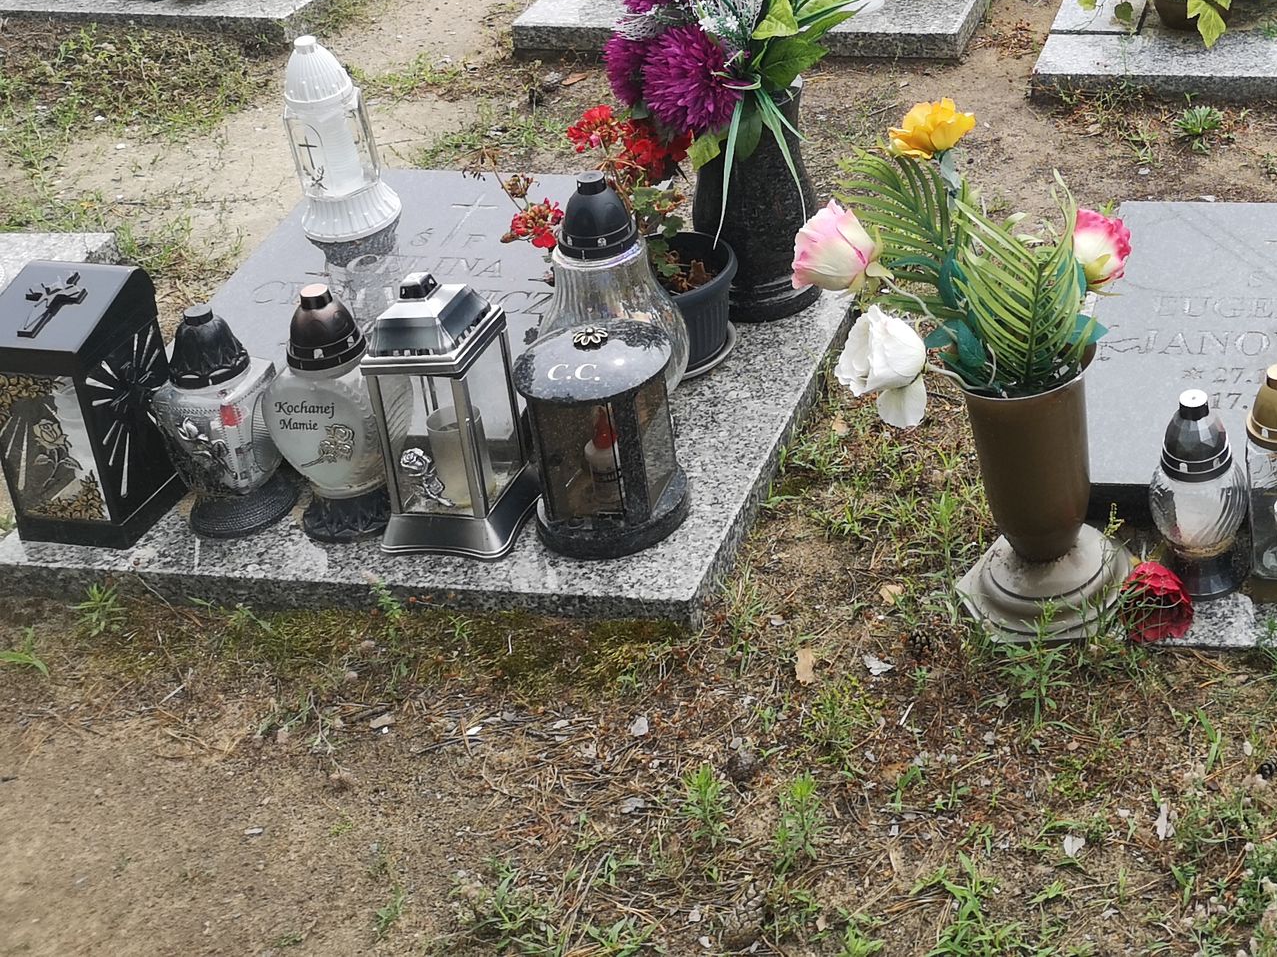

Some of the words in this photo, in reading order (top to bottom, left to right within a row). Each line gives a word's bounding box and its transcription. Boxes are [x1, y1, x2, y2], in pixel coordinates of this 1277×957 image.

[547, 363, 601, 382] C.C.
[274, 400, 335, 420] Kochanej
[279, 417, 319, 431] Mamie
